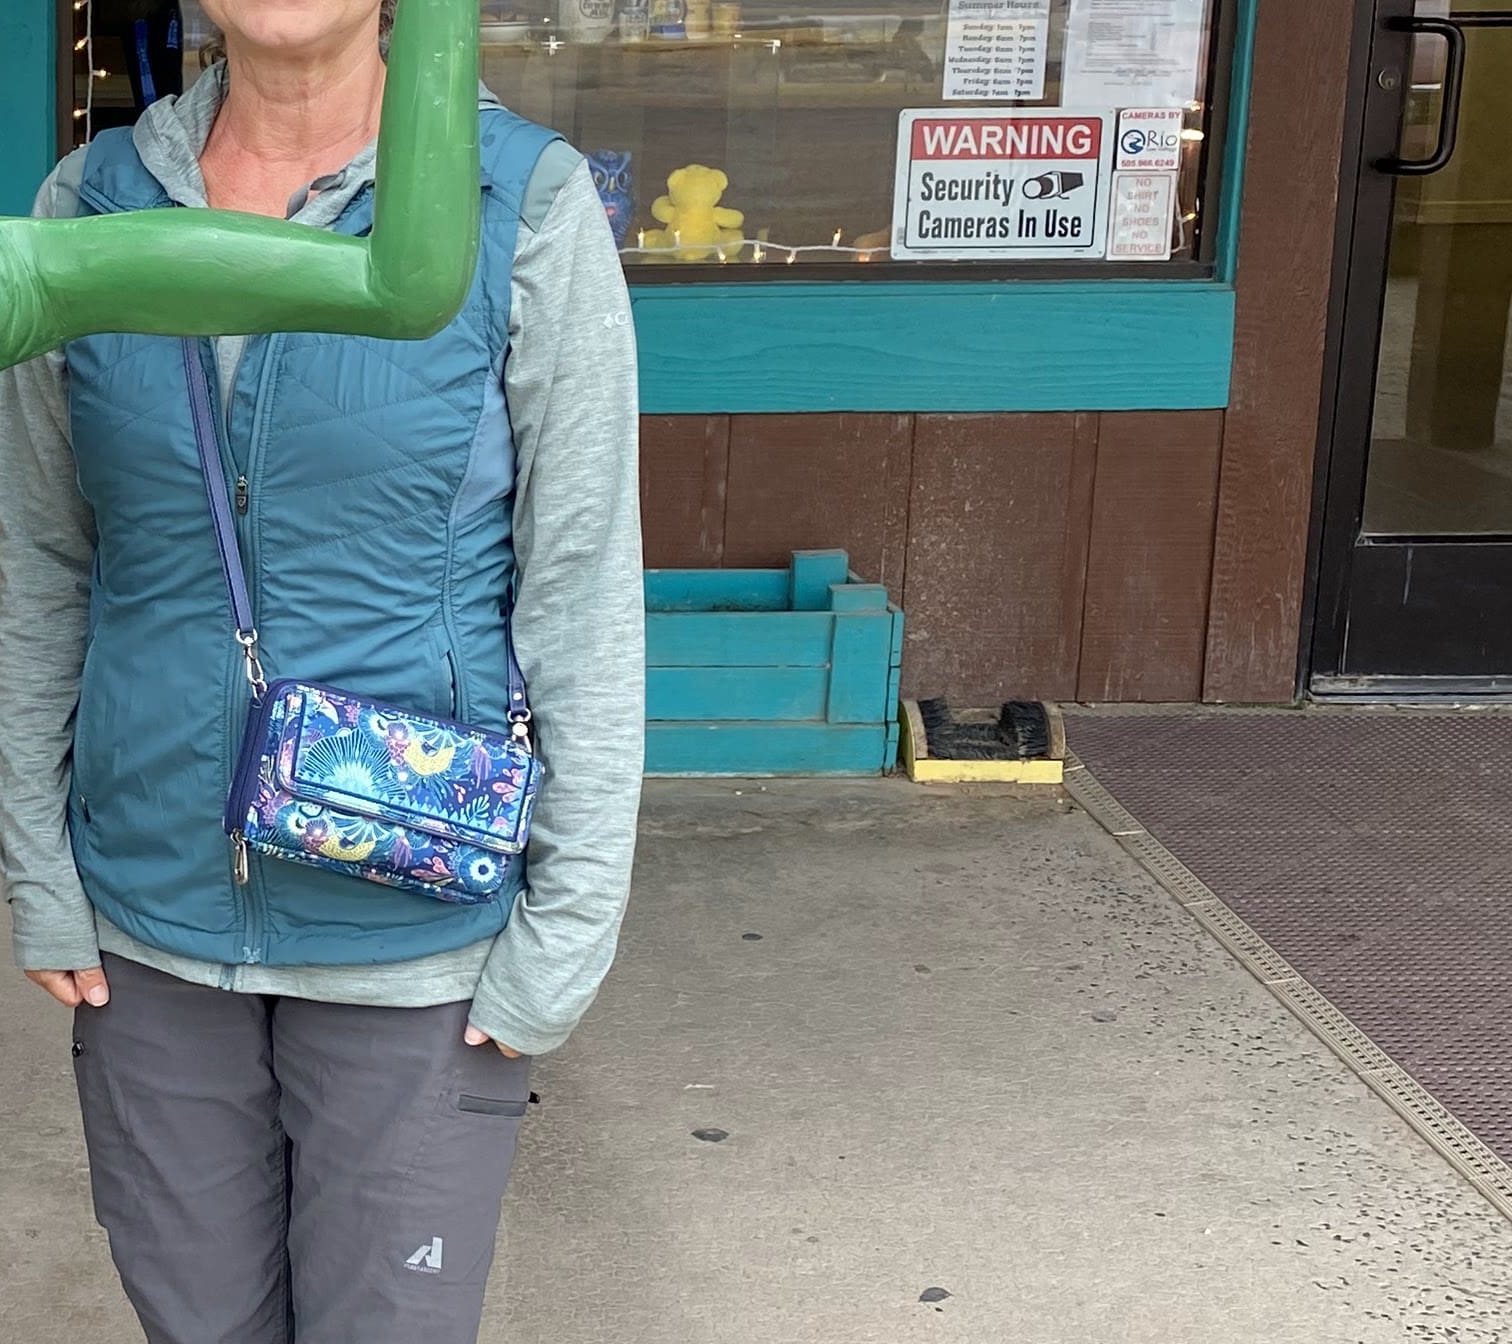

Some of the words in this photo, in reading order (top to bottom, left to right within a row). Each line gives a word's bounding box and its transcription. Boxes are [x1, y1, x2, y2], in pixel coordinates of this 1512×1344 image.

[1122, 112, 1166, 120] CAMERAS
[1169, 112, 1181, 120] BY
[922, 124, 1092, 156] WARNING
[1147, 130, 1178, 148] Rio
[1136, 178, 1152, 187] NO
[920, 171, 1015, 207] Security
[1127, 191, 1159, 201] SHIRT
[1134, 204, 1150, 213] NO
[918, 210, 1010, 239] Cameras
[1017, 210, 1040, 238] In
[1045, 210, 1082, 238] Use
[1122, 217, 1159, 226] SHOES
[1132, 230, 1148, 240] NO
[1115, 243, 1161, 253] SERVICE
